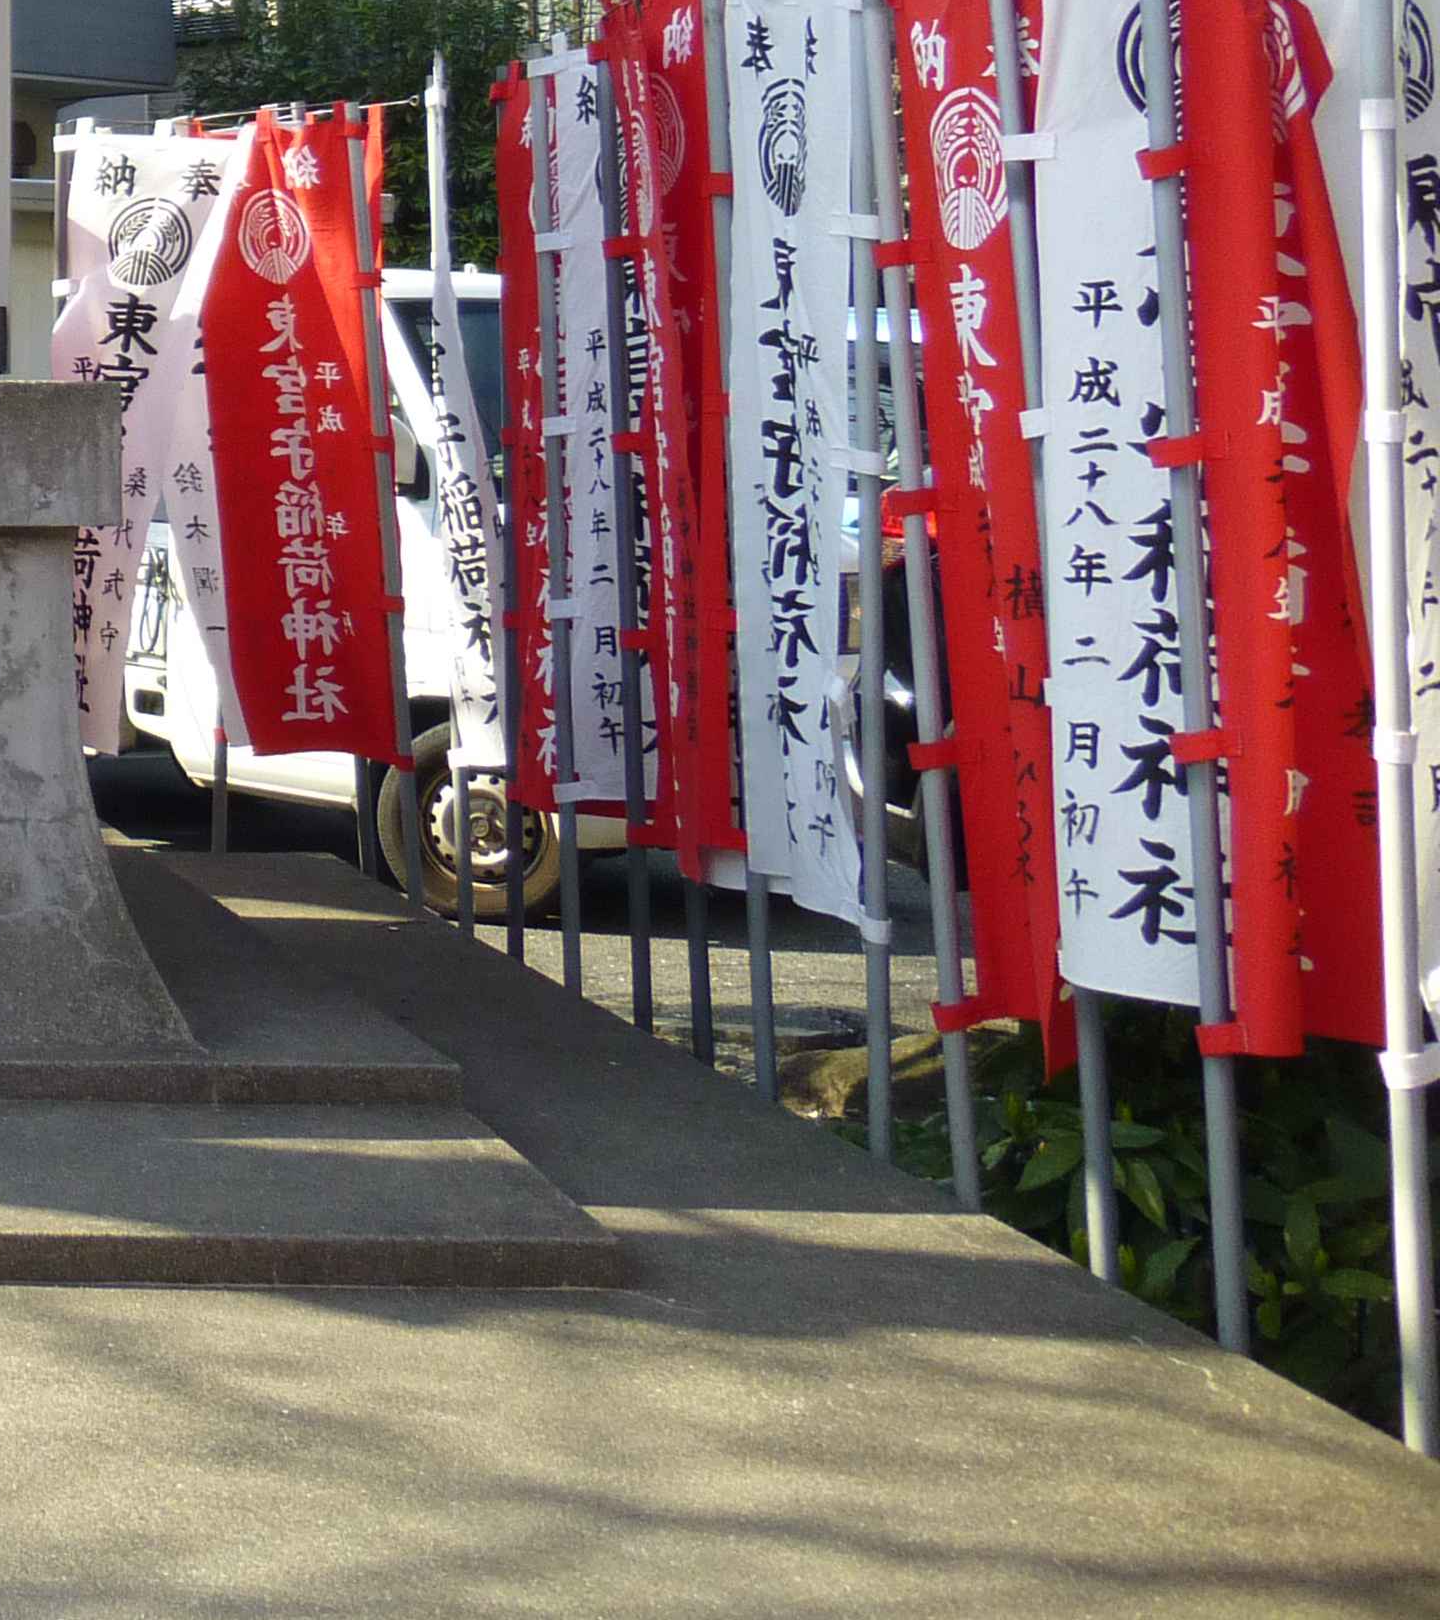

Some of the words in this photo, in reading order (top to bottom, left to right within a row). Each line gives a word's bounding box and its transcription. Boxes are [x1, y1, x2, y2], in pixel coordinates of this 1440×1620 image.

[583, 327, 627, 757] 平成二十八年二月初午
[1060, 280, 1123, 920] 平成二十八年二月初午
